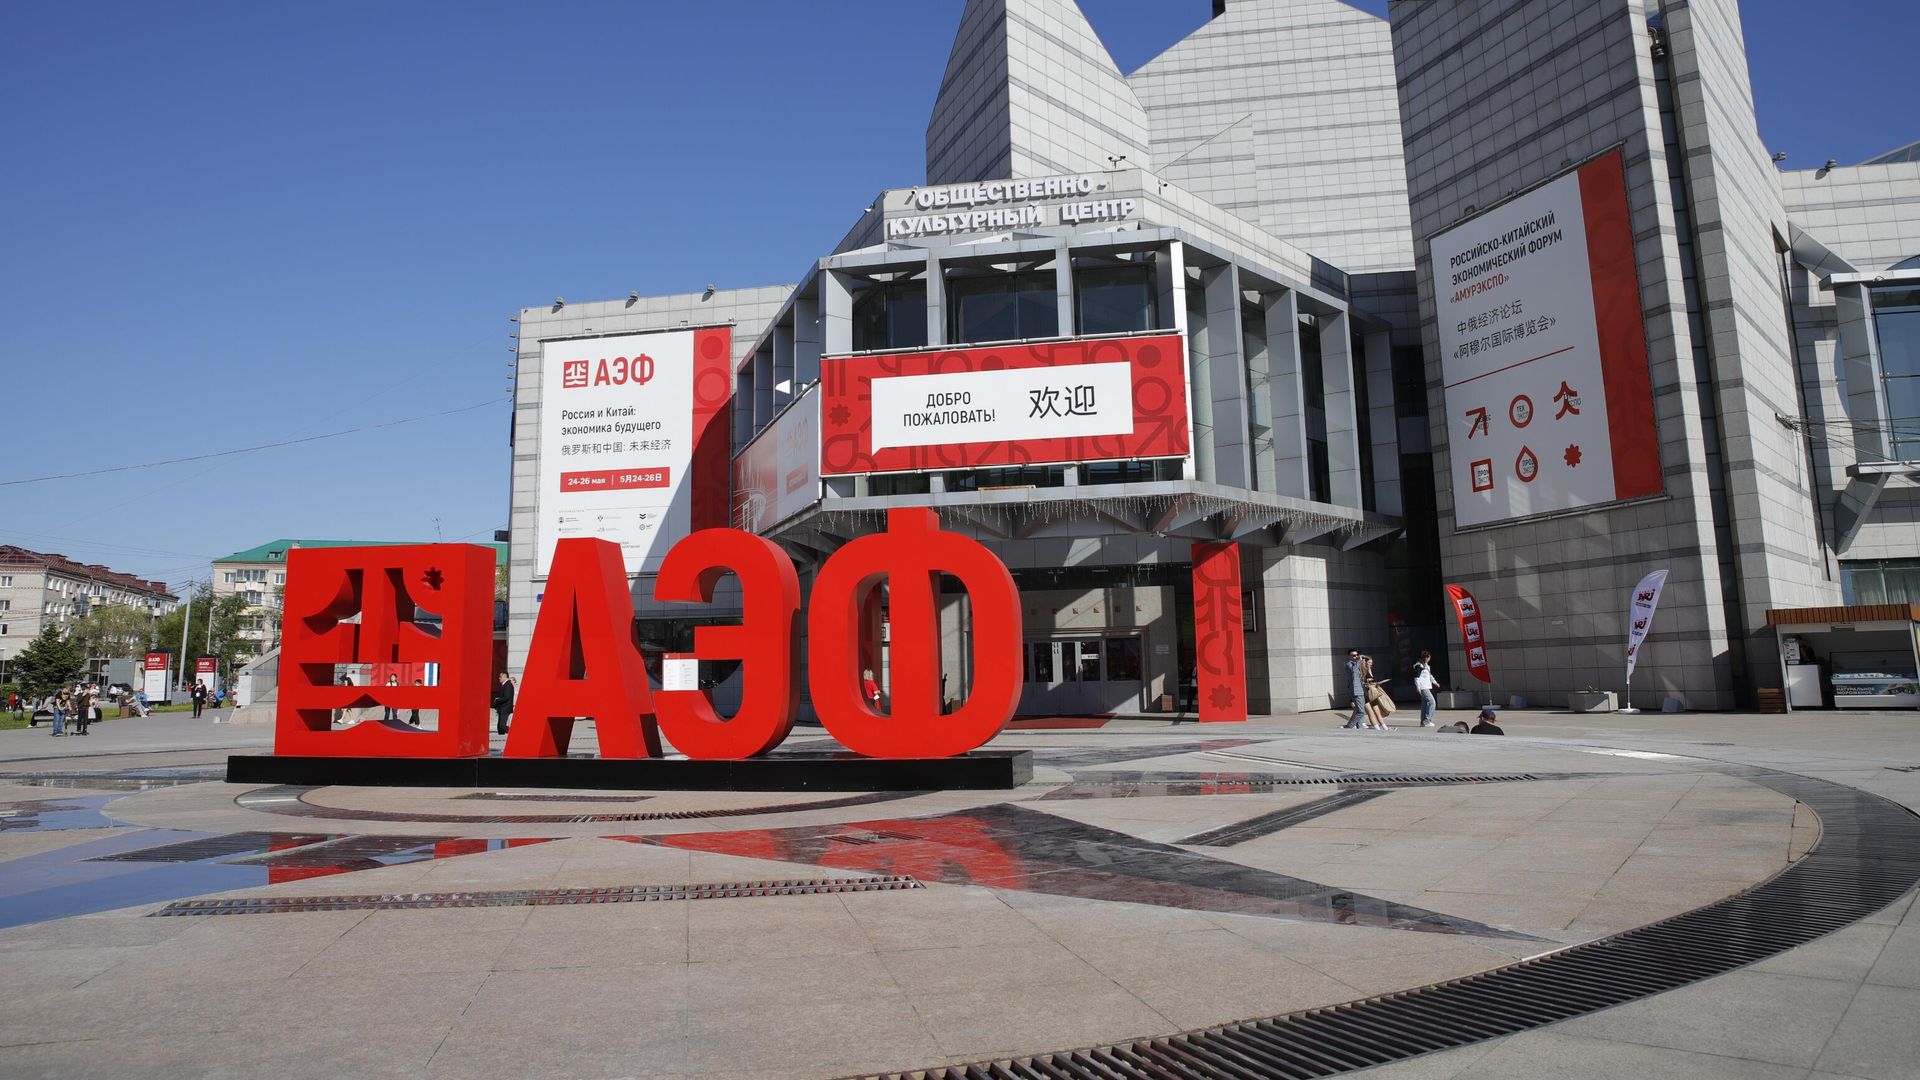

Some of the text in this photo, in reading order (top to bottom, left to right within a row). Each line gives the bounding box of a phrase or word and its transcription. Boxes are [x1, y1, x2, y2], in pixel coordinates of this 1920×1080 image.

[889, 199, 1136, 236] КУЛЬТУРНЫЙ ЦЕНТР
[1450, 210, 1556, 269] РОССИЙСКО-КИТАЙСКИЙ
[1452, 229, 1563, 286] ЭКОНОМИЧЕСКИЙ ФОРУМ
[1450, 273, 1510, 304] «АМУРЭКСПО»
[1457, 299, 1523, 336] 中俄经济论坛
[594, 353, 654, 387] АЭФ
[562, 405, 637, 420] Россия и Китай:
[926, 391, 971, 408] ДОБРО
[1028, 384, 1098, 419] 欢迎
[561, 420, 661, 436] экономика будущего
[903, 408, 996, 427] ПОЖАЛОВАТЬ!
[568, 476, 605, 486] 24-26 мая
[620, 473, 662, 484] 5月24-26日
[504, 508, 1022, 761] АЭФ
